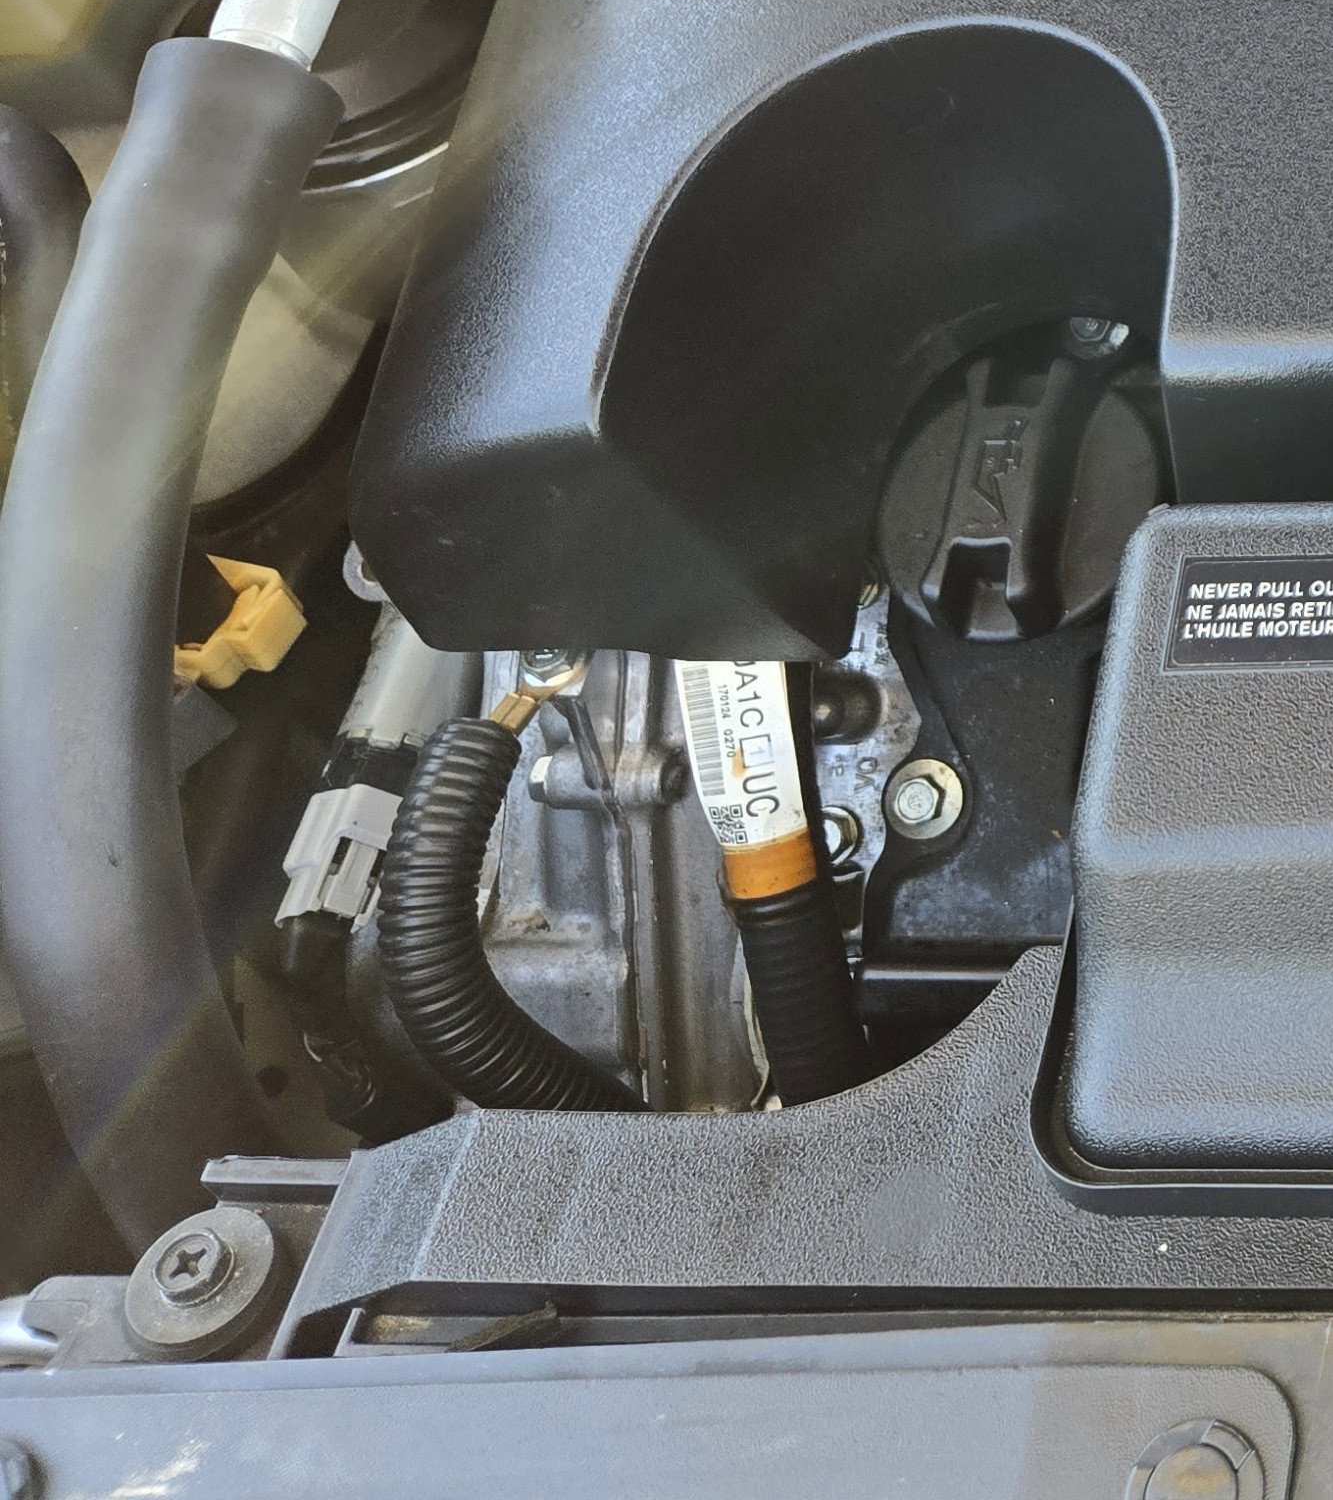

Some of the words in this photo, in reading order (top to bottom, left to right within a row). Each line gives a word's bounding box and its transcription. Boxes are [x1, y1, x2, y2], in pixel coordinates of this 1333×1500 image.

[1189, 583, 1253, 600] NEVER
[1257, 581, 1304, 598] PULL
[1186, 604, 1213, 621] NE
[1217, 602, 1285, 620] JAMAIS
[1183, 622, 1253, 640] L'HUILE
[718, 684, 731, 719] 170124
[724, 729, 737, 758] 0270
[742, 771, 780, 818] UC
